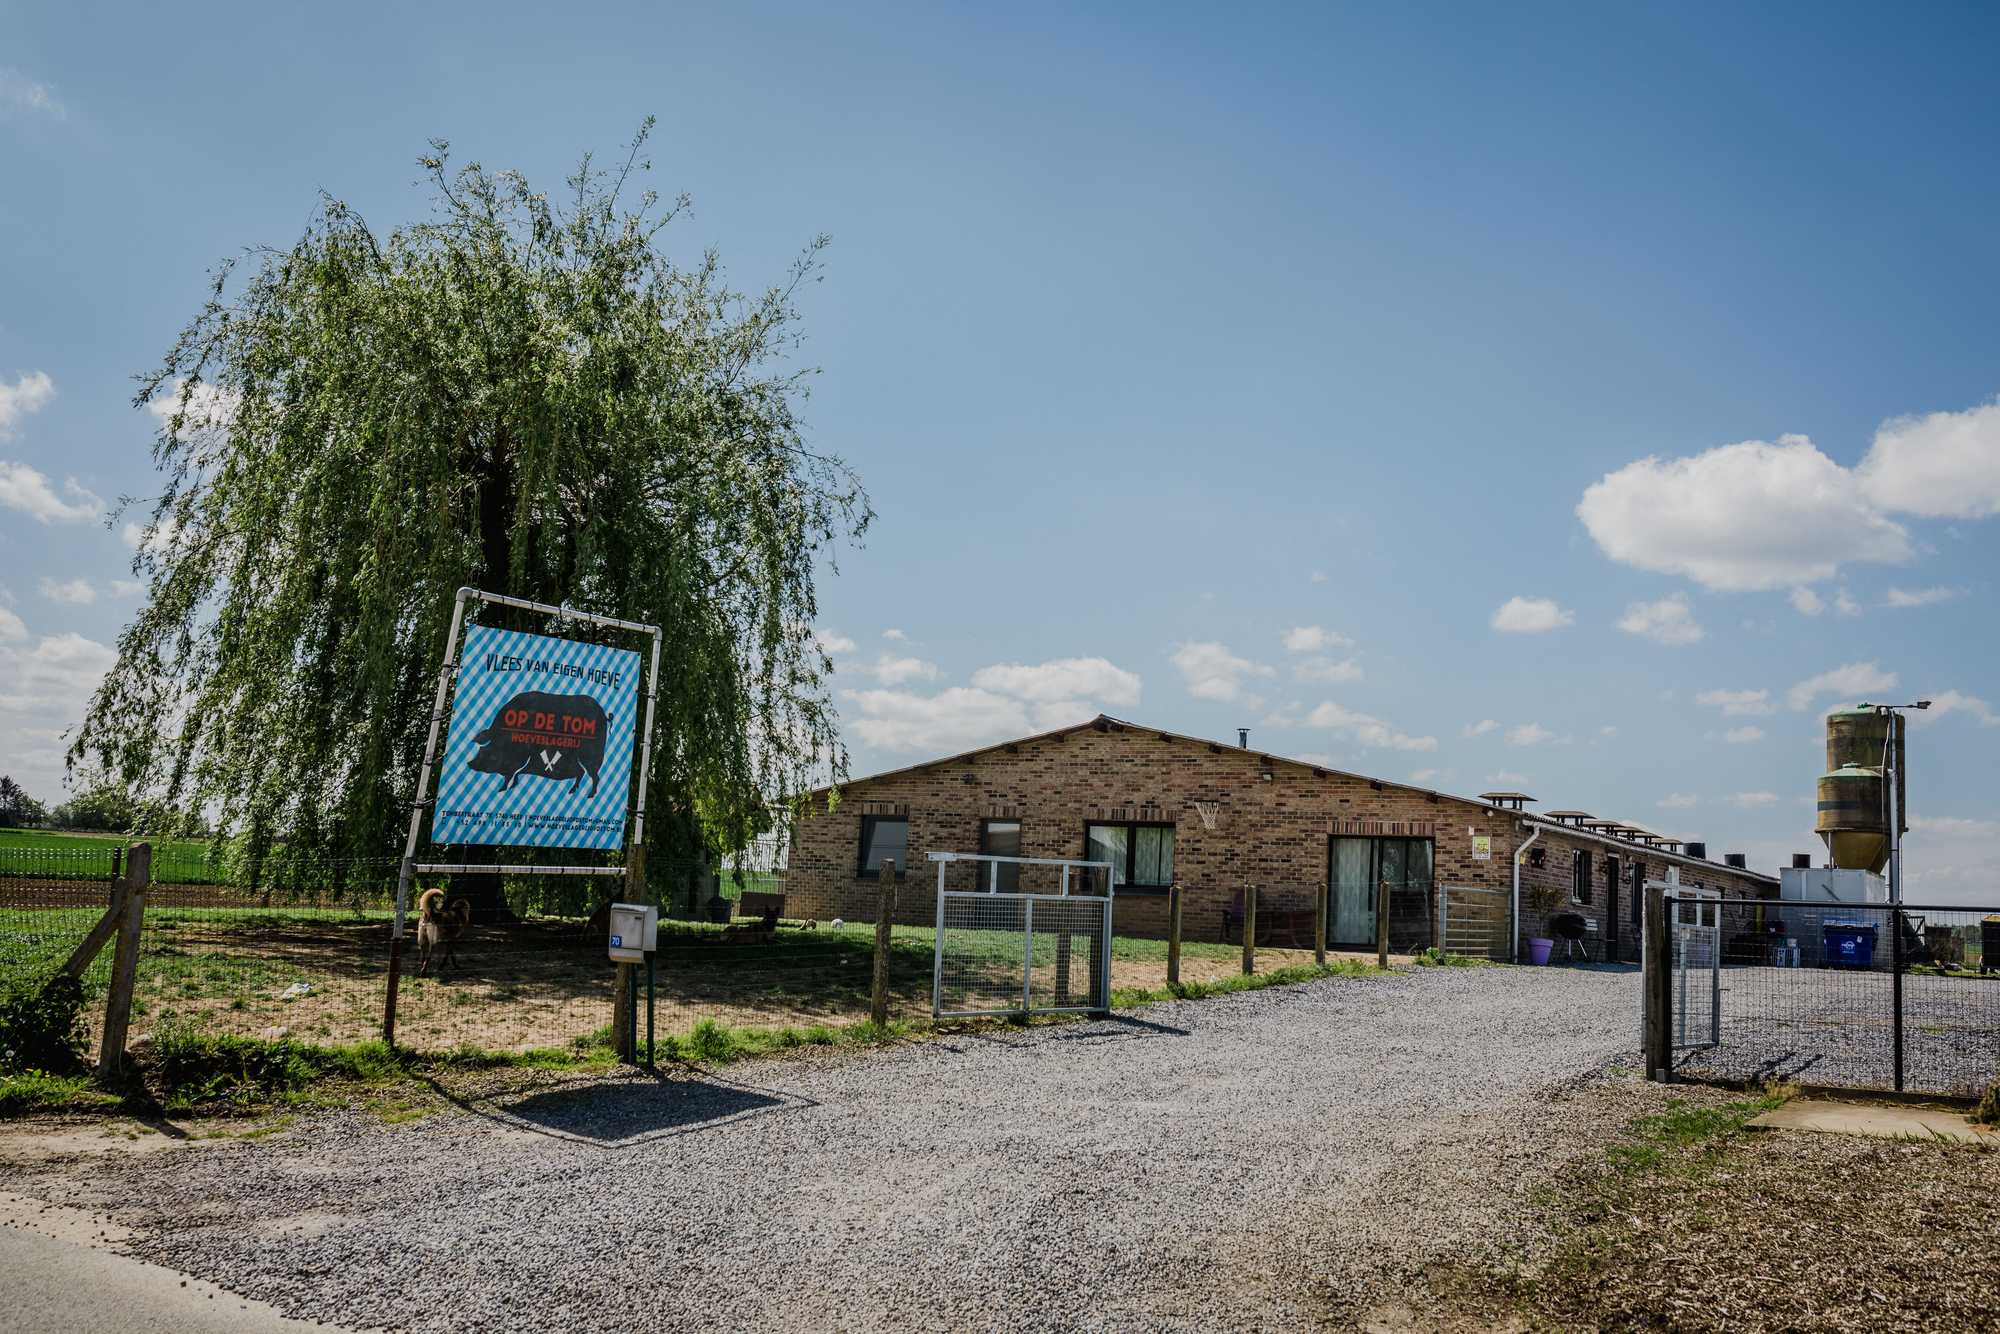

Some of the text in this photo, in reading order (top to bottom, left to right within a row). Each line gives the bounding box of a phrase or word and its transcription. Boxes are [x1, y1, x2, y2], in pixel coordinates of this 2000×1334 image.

[487, 654, 621, 690] VLEES VAN EIGEN HOEVE
[504, 709, 596, 736] OP DE TOM
[511, 732, 582, 748] HOEVESLAGERIJ
[612, 937, 620, 945] 70
